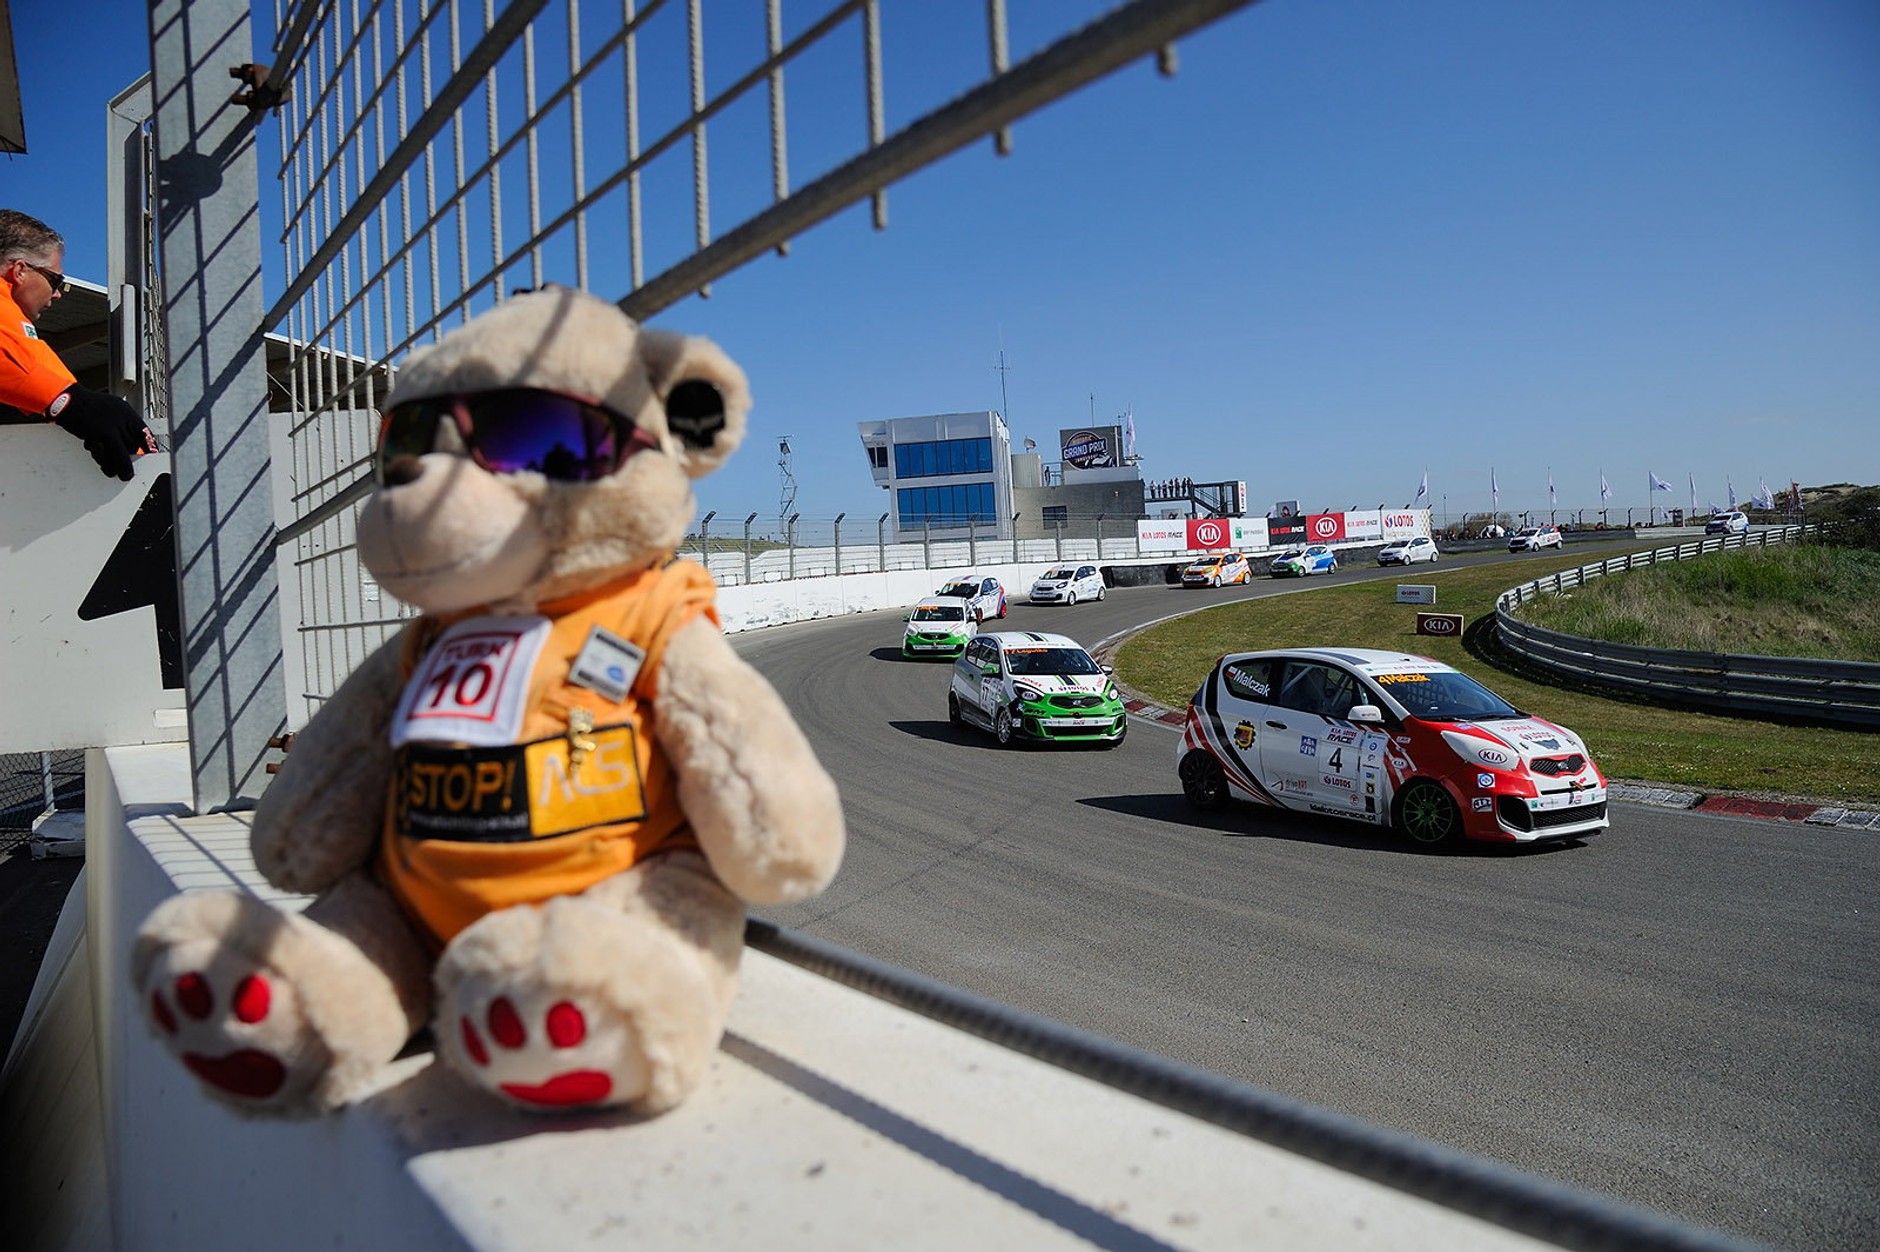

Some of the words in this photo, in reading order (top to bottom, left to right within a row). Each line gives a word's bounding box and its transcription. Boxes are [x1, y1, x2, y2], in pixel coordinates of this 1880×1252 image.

[1063, 444, 1088, 459] GRAND
[1088, 440, 1105, 454] PRIX
[1319, 521, 1334, 533] KIA
[1394, 515, 1413, 527] LOTOS
[1200, 528, 1218, 540] KIA
[1429, 620, 1450, 630] KIA
[430, 662, 493, 707] 10
[1233, 669, 1271, 697] Malczak
[1327, 734, 1354, 744] RACE
[1328, 747, 1343, 773] 4
[1483, 751, 1502, 762] KIA
[408, 759, 517, 812] STOP!
[1332, 777, 1352, 789] LOTOS
